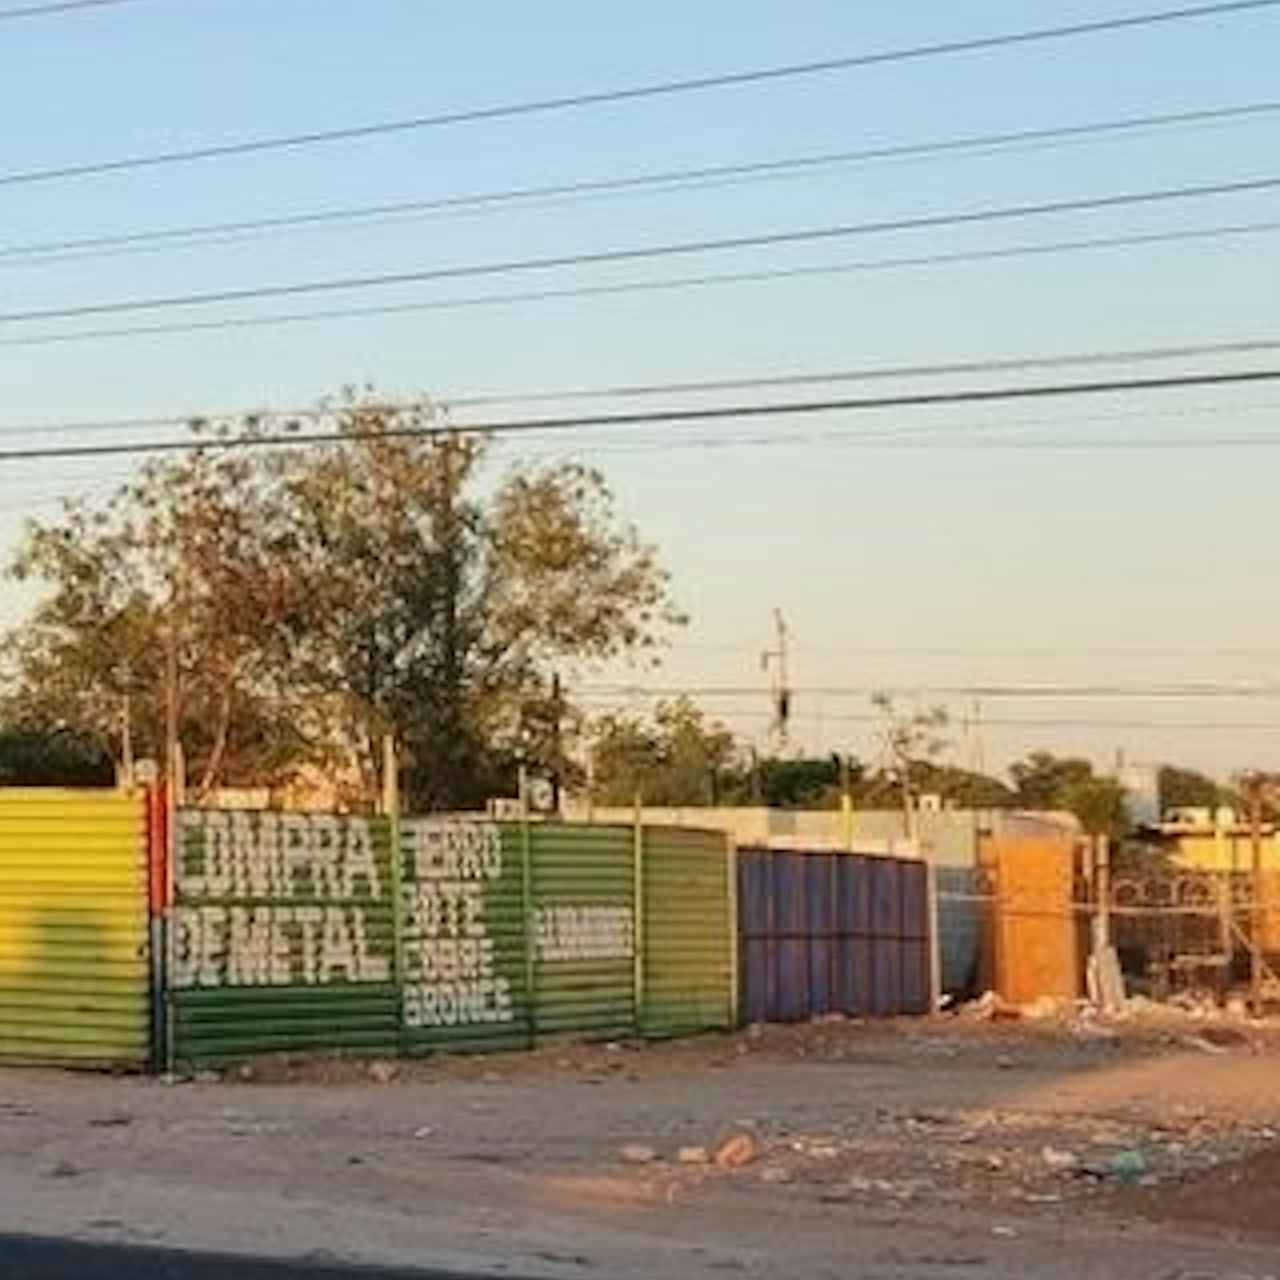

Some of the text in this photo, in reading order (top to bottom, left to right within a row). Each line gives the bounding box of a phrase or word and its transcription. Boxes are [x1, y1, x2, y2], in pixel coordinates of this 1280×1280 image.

[175, 811, 382, 900] COMPRA
[173, 907, 391, 987] DE METAL
[402, 977, 514, 1027] BRONCE
